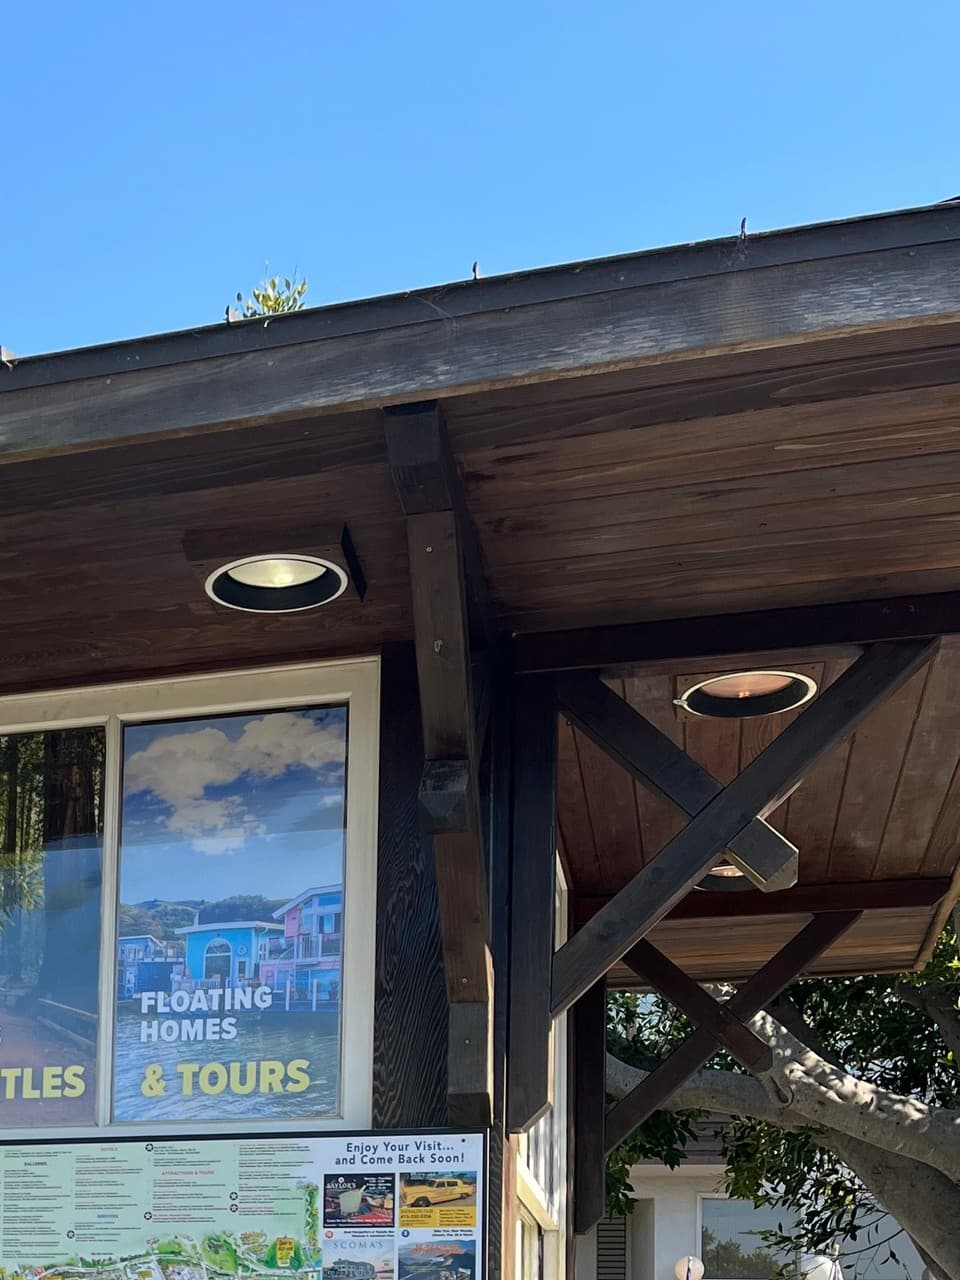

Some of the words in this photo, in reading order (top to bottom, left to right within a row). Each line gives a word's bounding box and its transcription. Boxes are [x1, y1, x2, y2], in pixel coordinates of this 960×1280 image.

[141, 985, 273, 1014] FLOATING
[140, 1016, 238, 1043] HOMES
[141, 1064, 167, 1098] &
[175, 1058, 311, 1096] TOURS
[335, 1155, 356, 1165] and
[360, 1155, 393, 1165] Come
[398, 1154, 425, 1164] Back
[430, 1153, 464, 1164] Soon!
[346, 1143, 378, 1155] Enjoy
[384, 1142, 410, 1152] Your
[414, 1140, 454, 1151] Visit...
